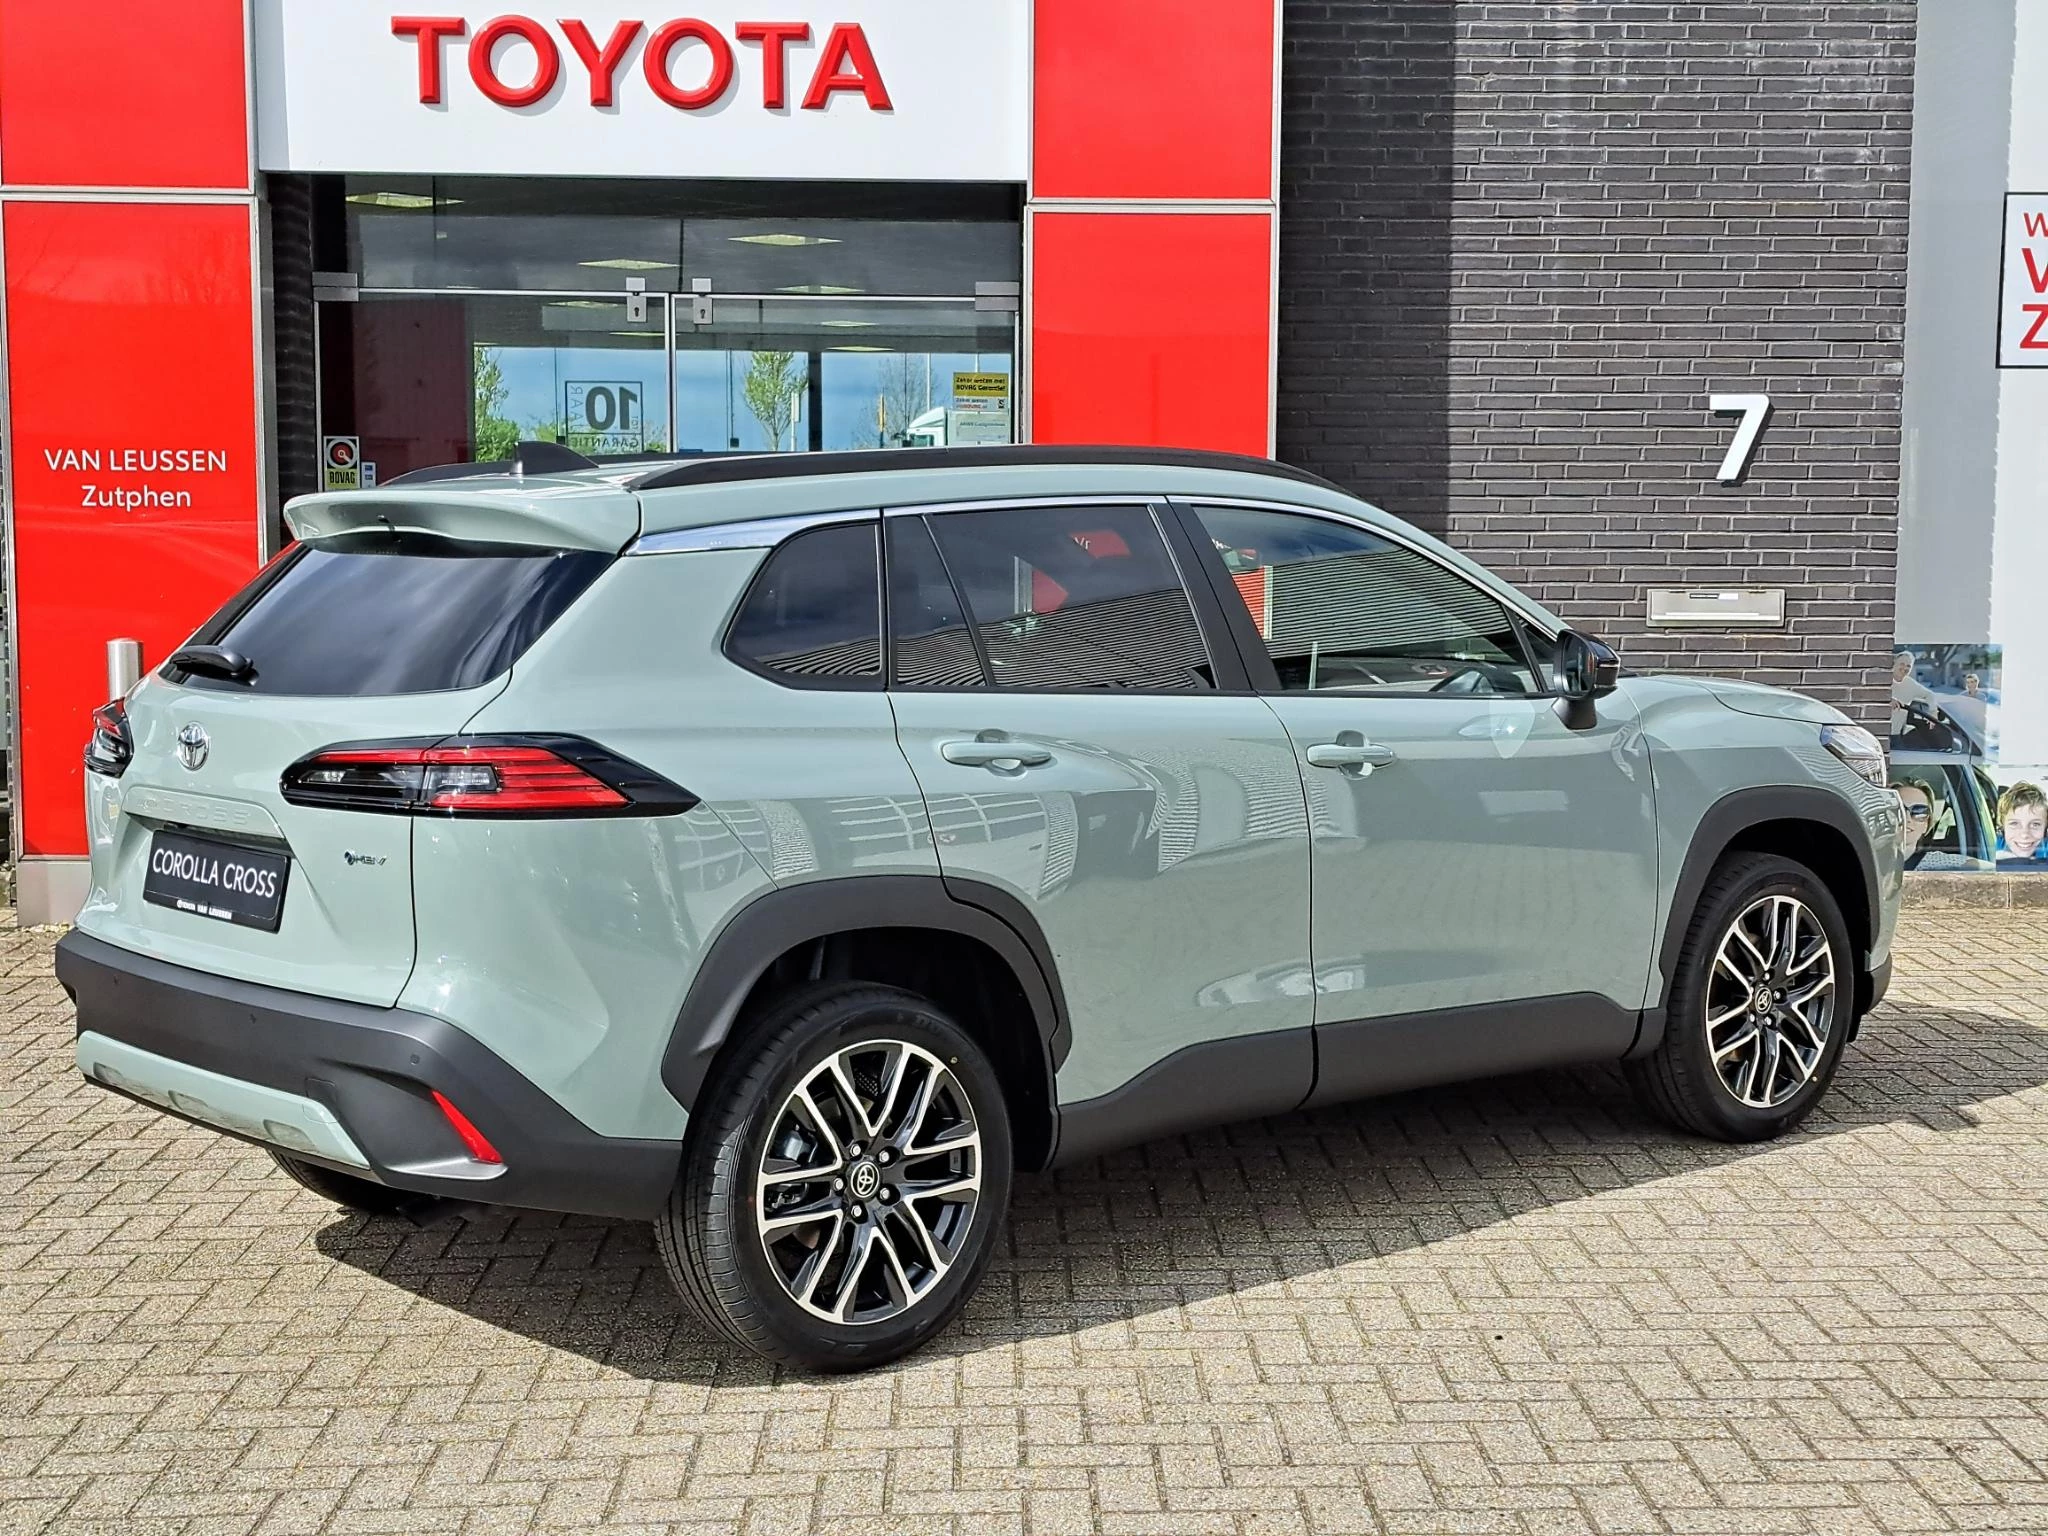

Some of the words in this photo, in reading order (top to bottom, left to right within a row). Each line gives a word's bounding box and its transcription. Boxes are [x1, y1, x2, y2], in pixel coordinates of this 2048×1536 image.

[391, 15, 894, 111] TOYOTA
[44, 449, 100, 471] VAN
[109, 449, 227, 472] LEUSSEN
[1709, 394, 1771, 481] 7
[81, 485, 191, 512] Zutphen
[152, 848, 219, 886] COROLLA
[223, 863, 277, 898] CROSS
